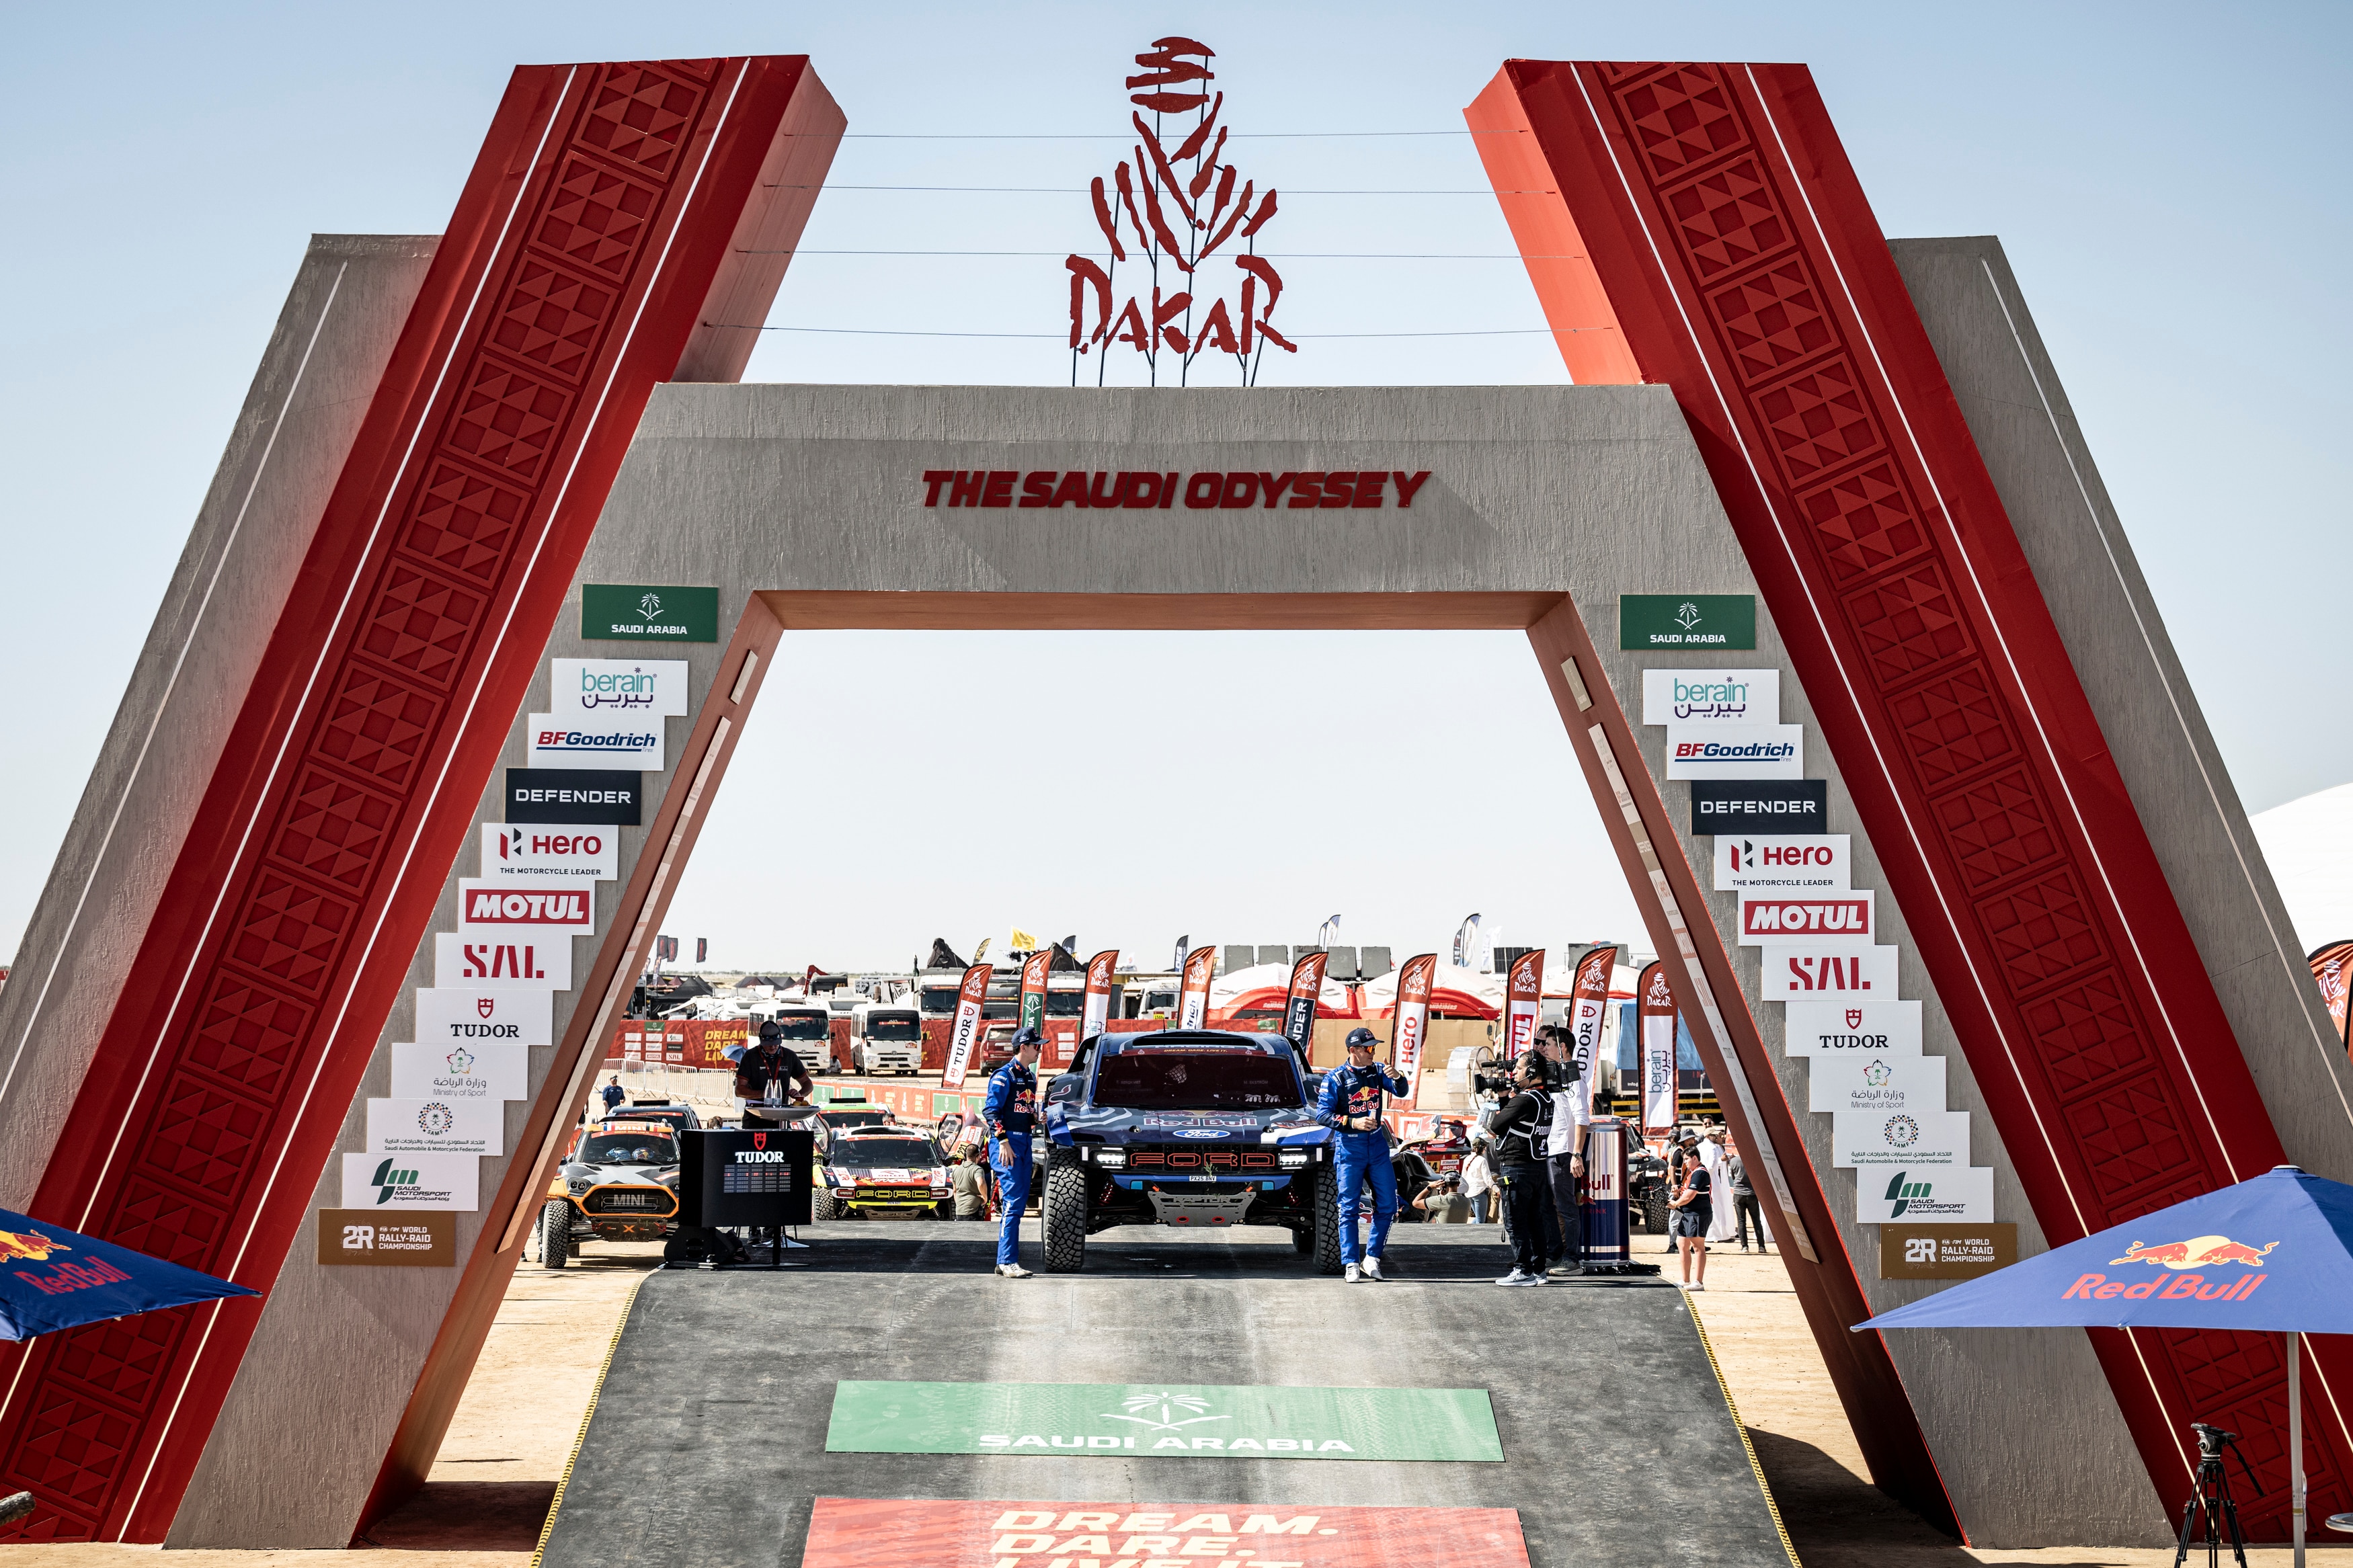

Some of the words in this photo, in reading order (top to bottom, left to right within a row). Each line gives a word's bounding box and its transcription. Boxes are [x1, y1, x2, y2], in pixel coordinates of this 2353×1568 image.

[1066, 254, 1297, 355] DAKAR
[922, 470, 1018, 508] THE
[1019, 470, 1179, 508] SAUDI
[1184, 470, 1433, 509] ODYSSEY
[611, 624, 643, 633] SAUDI
[646, 625, 688, 634] ARABIA
[1650, 634, 1682, 643] SAUDI
[1685, 634, 1726, 643] ARABIA
[582, 694, 653, 708] بيرين
[1674, 703, 1746, 719] بيرين
[538, 731, 656, 747] BFGoodrich
[1676, 743, 1794, 757] BFGoodrich
[516, 789, 631, 804] DEFENDER
[1700, 800, 1817, 813] DEFENDER
[532, 835, 602, 855] Hero
[1763, 846, 1833, 866] Hero
[471, 895, 584, 919] MOTUL
[1749, 905, 1863, 930] MOTUL
[1027, 977, 1045, 987] DAKAR
[1091, 976, 1109, 988] DAKAR
[1189, 974, 1206, 985] DAKAR
[1297, 979, 1317, 992] DAKAR
[1581, 979, 1605, 993] DAKAR
[965, 986, 982, 999] DAKAR
[1405, 983, 1426, 996] DAKAR
[1515, 982, 1537, 993] DAKAR
[1647, 995, 1672, 1007] DAKAR
[450, 1024, 520, 1038] TUDOR
[954, 1019, 971, 1065] TUDOR
[1401, 1016, 1417, 1064] Hero
[1578, 1022, 1593, 1071] UDOR
[1819, 1035, 1888, 1048] TUDOR
[1647, 1050, 1662, 1093] berain
[434, 1077, 463, 1088] الرياضة
[466, 1078, 487, 1088] وزارة
[433, 1089, 457, 1097] Ministry
[467, 1089, 486, 1098] Sport
[1851, 1089, 1880, 1100] الرياضة
[1884, 1089, 1905, 1100] وزارة
[1349, 1104, 1367, 1114] Red
[1851, 1101, 1876, 1109] Ministry
[1885, 1101, 1905, 1110] Sport
[1144, 1118, 1201, 1127] Red
[1203, 1118, 1257, 1127] Bull
[957, 1144, 967, 1155] 221
[735, 1151, 785, 1163] TUDOR
[1131, 1153, 1275, 1167] FORD
[1581, 1174, 1611, 1190] Bull
[613, 1194, 645, 1206] MINI
[856, 1190, 930, 1198] FORD
[378, 1234, 430, 1243] RALLY-RAID
[12, 1264, 92, 1295] Red
[58, 1255, 132, 1286] Bull
[2061, 1273, 2171, 1299] Red
[2157, 1274, 2268, 1301] Bull
[979, 1434, 1135, 1448] SAUDI
[1152, 1437, 1355, 1452] ARABIA
[990, 1511, 1339, 1535] DREAM.
[988, 1534, 1257, 1557] DARE.
